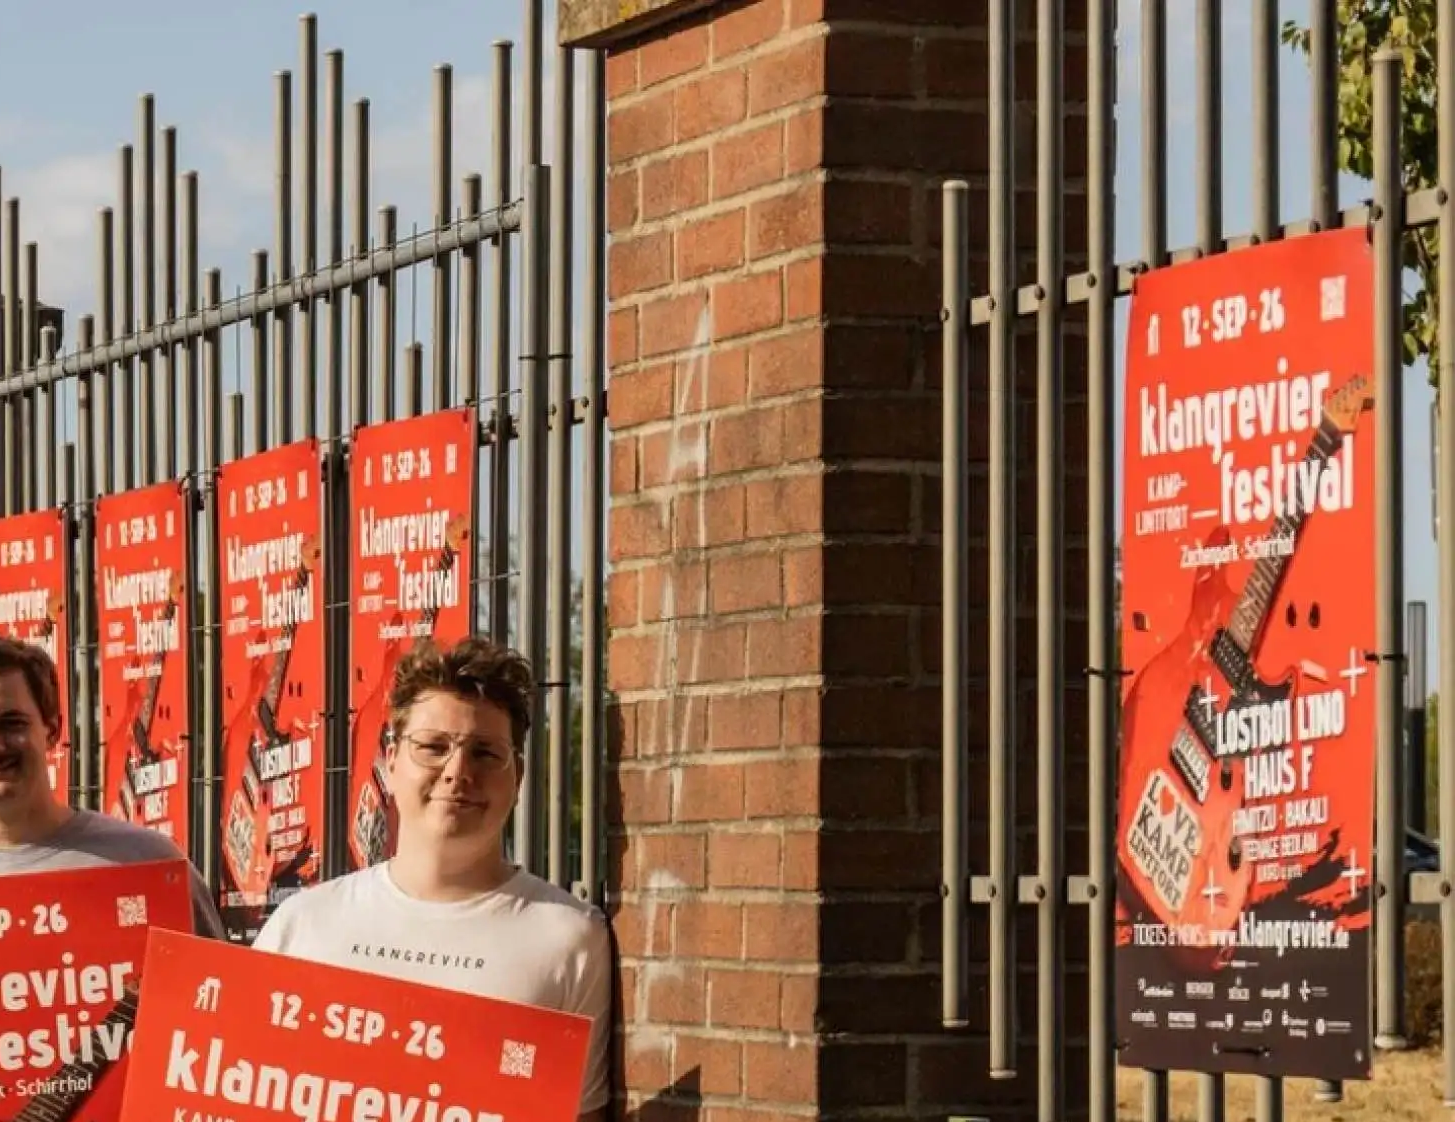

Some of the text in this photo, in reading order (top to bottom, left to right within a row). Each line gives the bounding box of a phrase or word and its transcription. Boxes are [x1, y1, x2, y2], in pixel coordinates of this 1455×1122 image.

[1181, 287, 1285, 348] 12 SEP 26
[1141, 357, 1331, 464] klangrevier
[1221, 434, 1353, 525] festival
[359, 497, 449, 568] klangrevier
[399, 554, 459, 612] festival
[1245, 745, 1314, 798] HAUS F
[32, 903, 69, 936] 26
[351, 943, 486, 970] KLANGREVIER
[270, 991, 445, 1060] 12 SEP 26
[15, 1074, 93, 1098] Schirrhof
